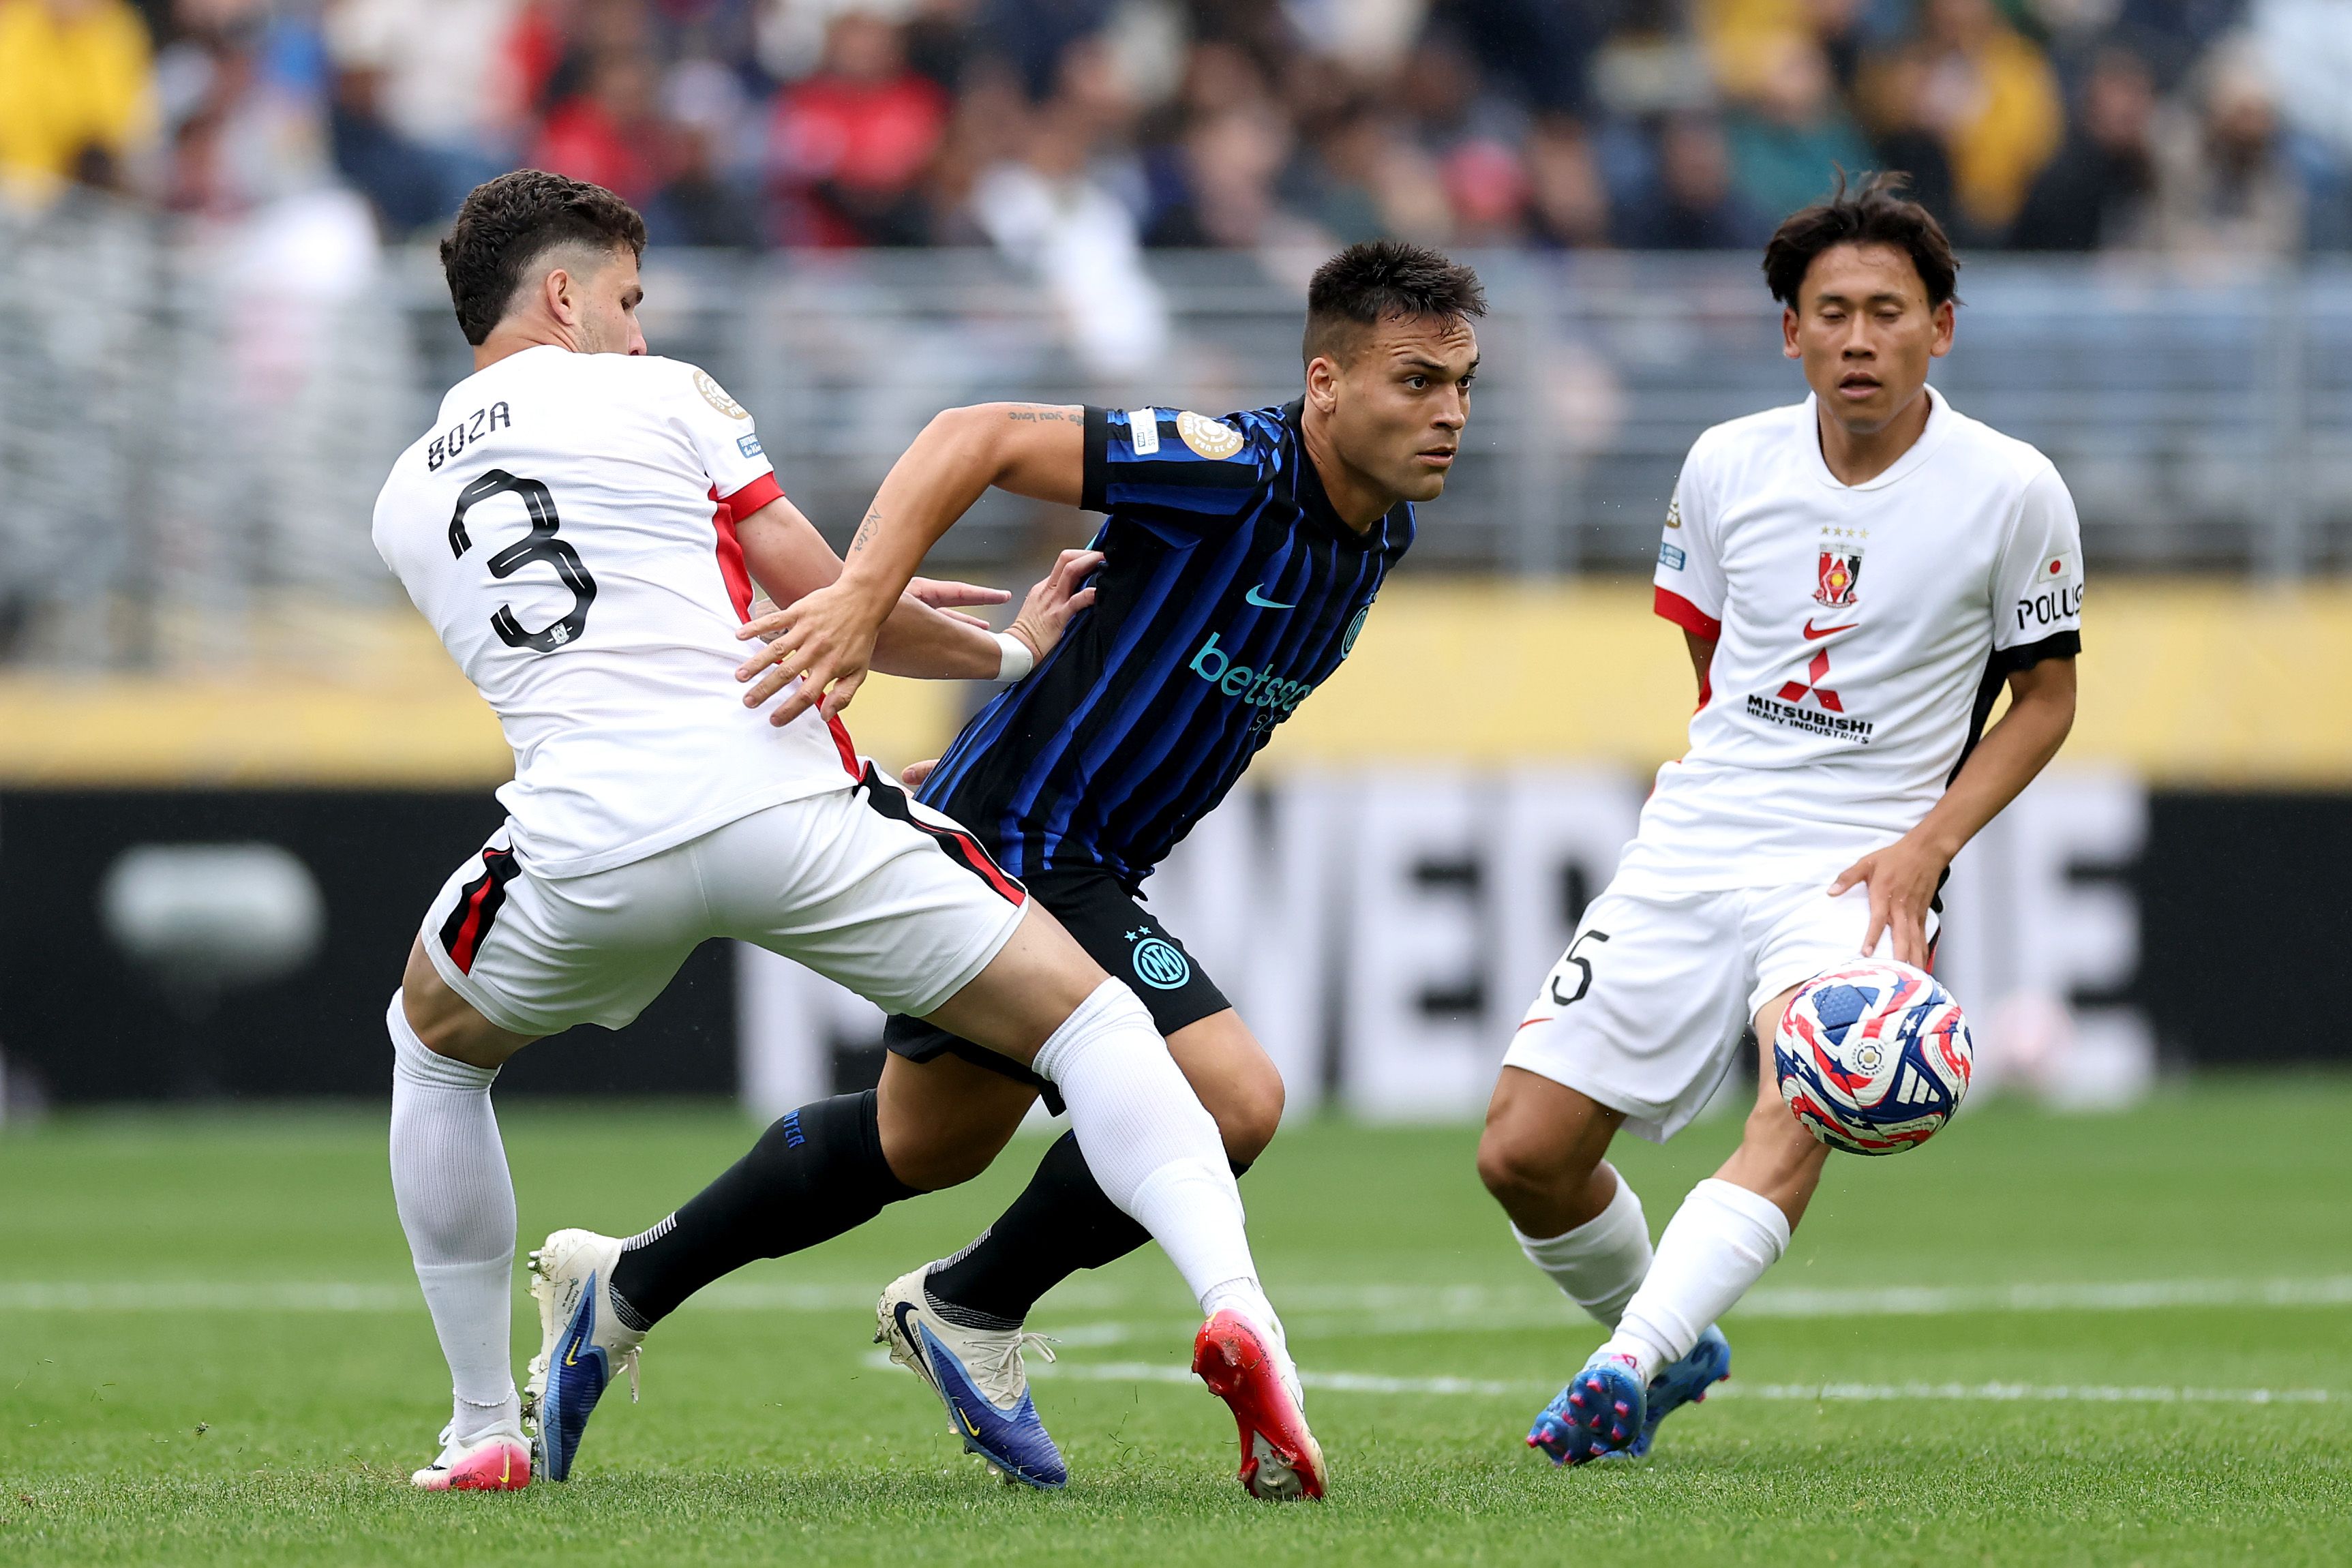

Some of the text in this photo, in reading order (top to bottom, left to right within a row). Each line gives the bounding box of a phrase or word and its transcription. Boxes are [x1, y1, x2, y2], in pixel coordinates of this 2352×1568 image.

[428, 401, 511, 472] BOZA
[1194, 437, 1211, 452] USA
[449, 468, 597, 652] 3
[1189, 631, 1313, 711] betsso
[1747, 706, 1870, 745] HEAVY INDUSTRIES
[1748, 694, 1873, 735] MITSUBISHI
